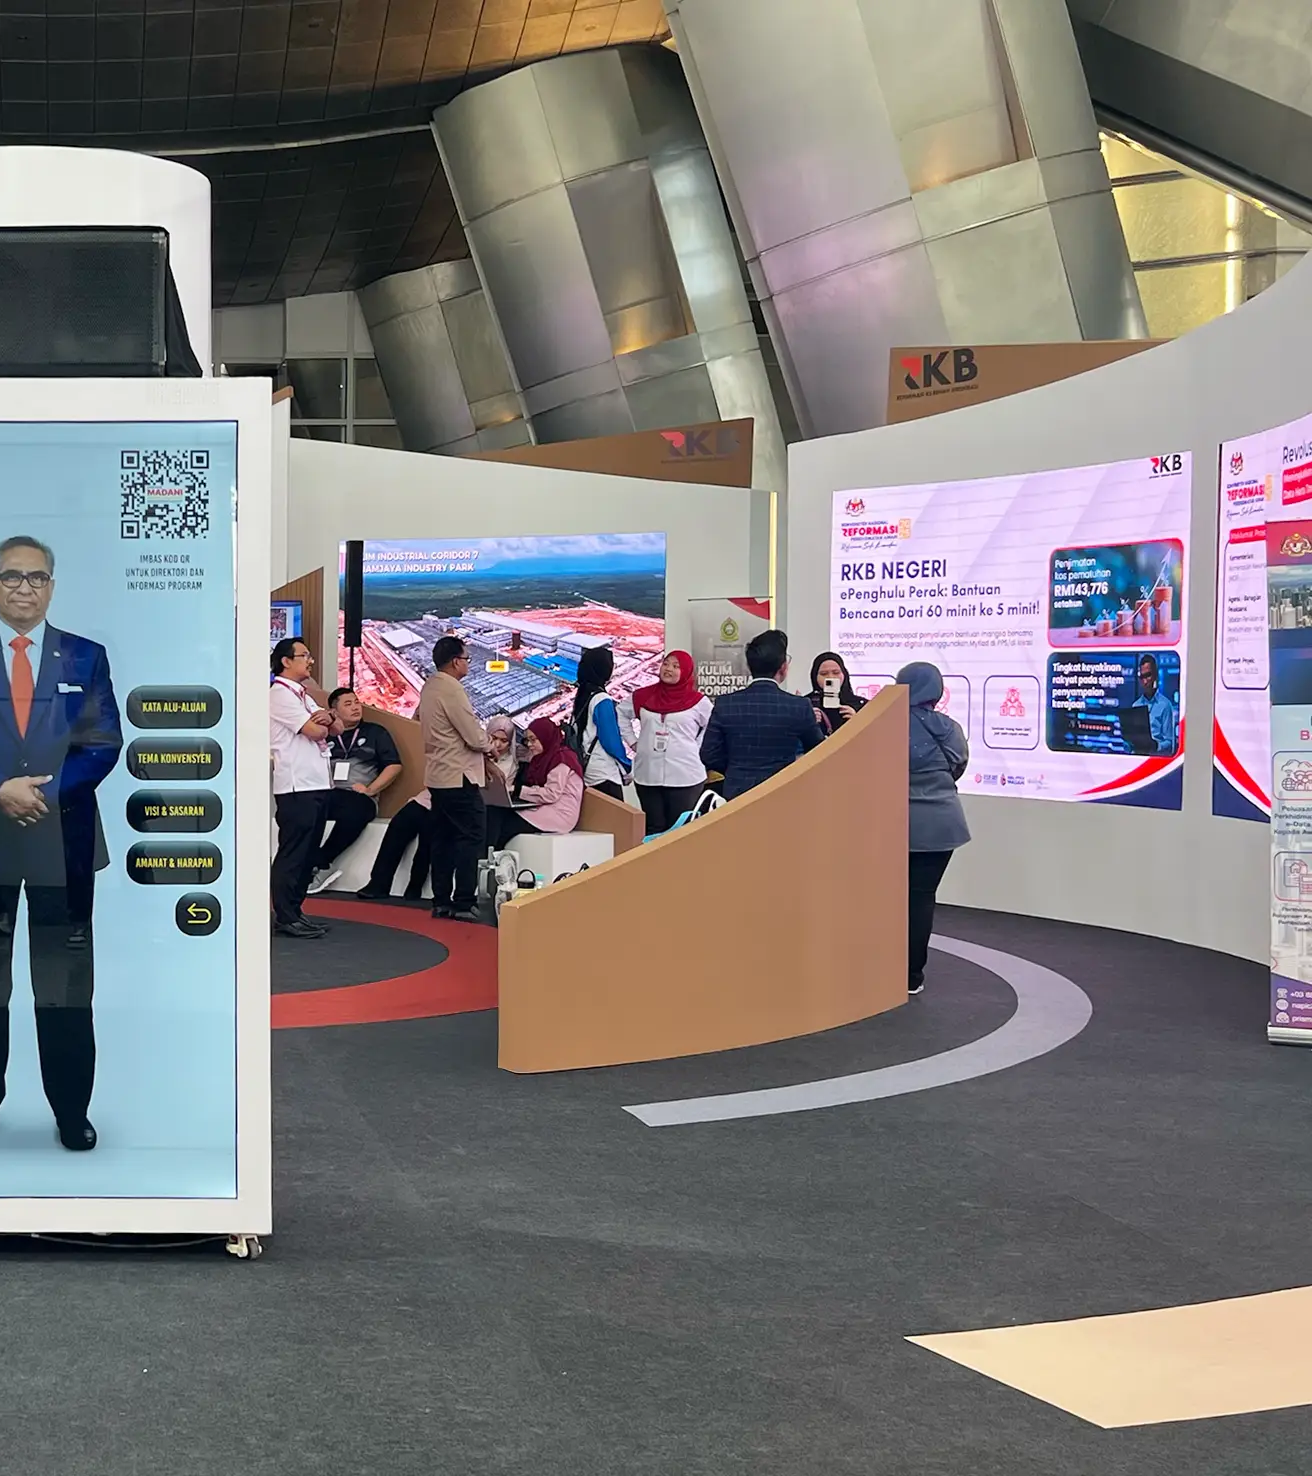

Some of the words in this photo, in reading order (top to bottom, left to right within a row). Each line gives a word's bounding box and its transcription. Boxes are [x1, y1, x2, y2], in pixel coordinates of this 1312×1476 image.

[147, 488, 184, 496] MADANI
[841, 525, 898, 537] REFORMASI
[140, 554, 162, 563] IMBAS
[164, 554, 178, 563] KOD
[180, 554, 190, 563] QR
[378, 552, 429, 561] INDUSTRIAL
[431, 551, 470, 560] CORIDOR
[473, 551, 479, 560] 7
[404, 564, 448, 573] INDUSTRY
[449, 563, 475, 572] PARK
[1055, 557, 1096, 569] Penjimatan
[125, 568, 150, 577] UNTUK
[151, 567, 188, 577] DIREKTORI
[189, 567, 204, 576] DAN
[841, 562, 876, 580] RKB
[882, 559, 946, 579] NEGERI
[1055, 571, 1067, 580] kos
[127, 581, 166, 590] INFORMASI
[168, 581, 202, 590] PROGRAM
[1054, 582, 1108, 597] RM143,776
[840, 585, 905, 603] ePenghulu
[909, 583, 948, 598] Perak:
[951, 584, 1001, 597] Bantuan
[840, 607, 895, 619] Bencana
[898, 605, 923, 618] Dari
[926, 605, 942, 617] 60
[946, 604, 976, 617] minit
[979, 602, 993, 616] ke
[996, 602, 1004, 615] 5
[1007, 600, 1040, 615] minit!
[1054, 600, 1083, 608] setahun
[698, 665, 733, 675] KULIM
[1052, 662, 1081, 674] Tingkat
[1082, 662, 1121, 674] keyakinan
[698, 675, 754, 686] INDUSTRIA
[1052, 676, 1077, 686] rakyat
[1078, 675, 1098, 686] pada
[142, 701, 161, 713] KATA
[163, 701, 207, 713] ALU-ALUAN
[138, 753, 159, 764] TEMA
[160, 753, 211, 764] KONVENSYEN
[144, 805, 159, 816] VISI
[161, 805, 168, 816] &
[169, 805, 205, 816] SASARAN
[135, 857, 167, 868] AMANAT
[169, 857, 175, 868] &
[177, 857, 213, 868] HARAPAN
